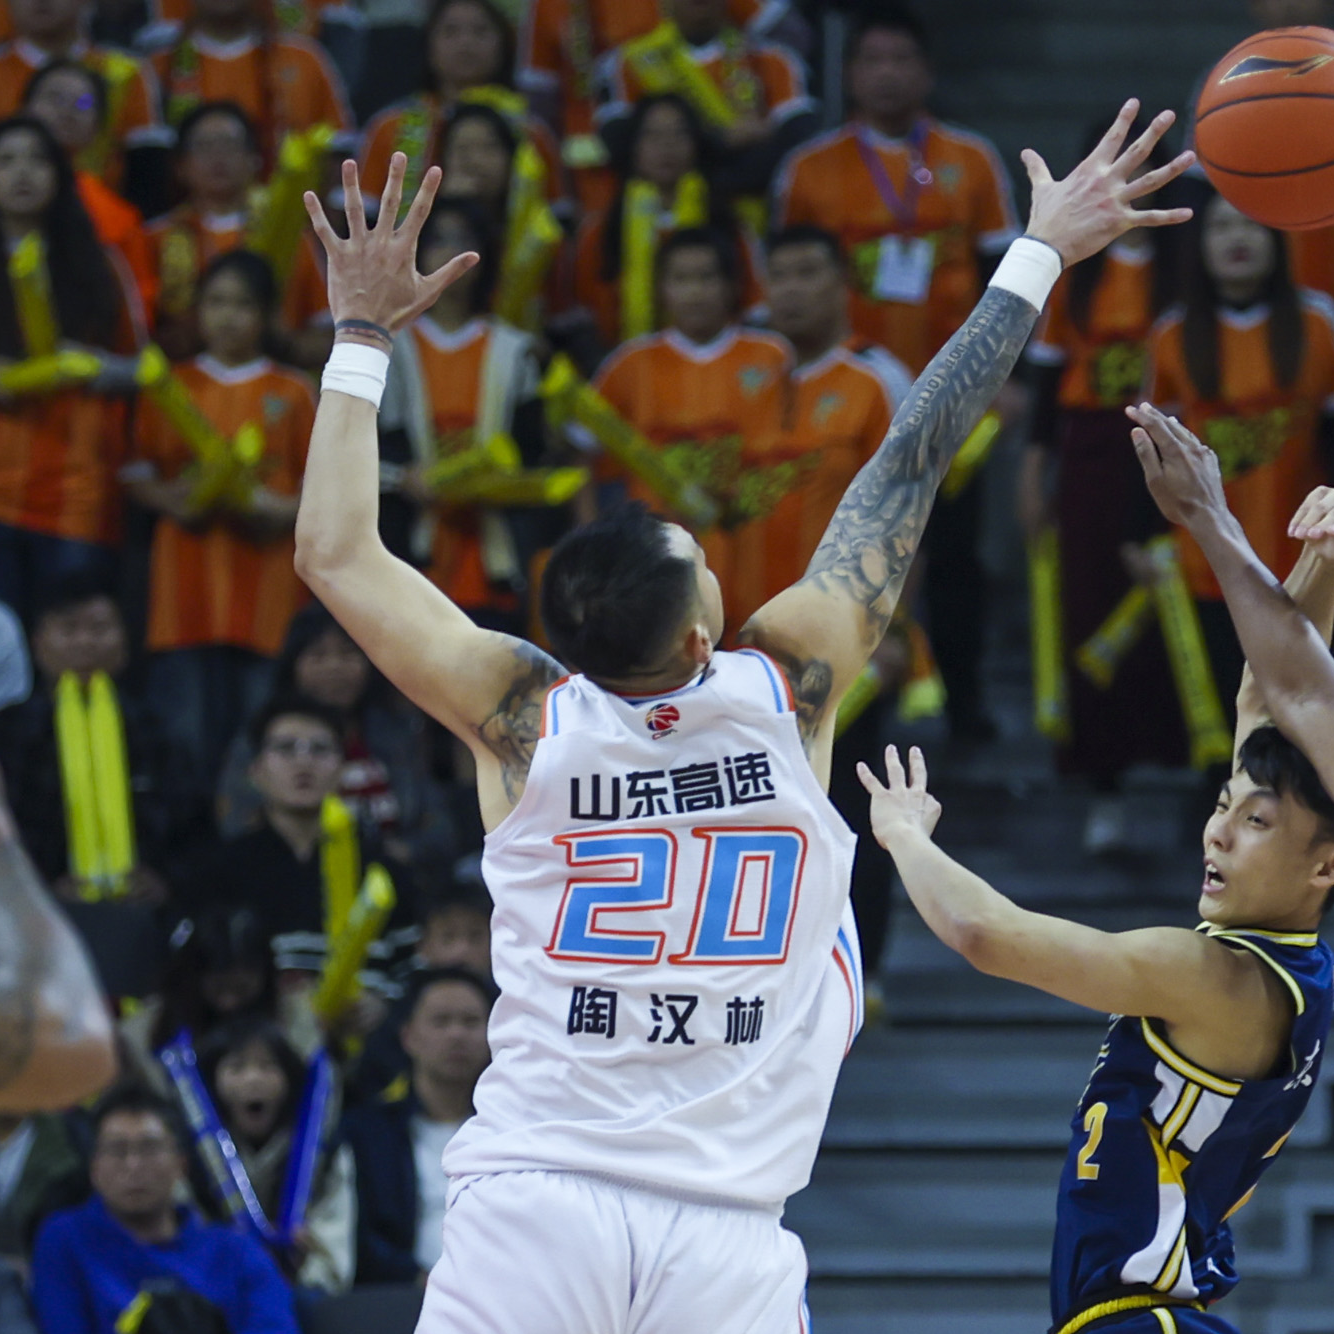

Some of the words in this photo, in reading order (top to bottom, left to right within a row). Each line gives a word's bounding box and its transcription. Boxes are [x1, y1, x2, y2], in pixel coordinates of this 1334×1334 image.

[570, 752, 776, 821] 山东高速
[543, 826, 808, 965] 20
[567, 986, 765, 1045] 陶汉林
[1076, 1101, 1108, 1180] 2
